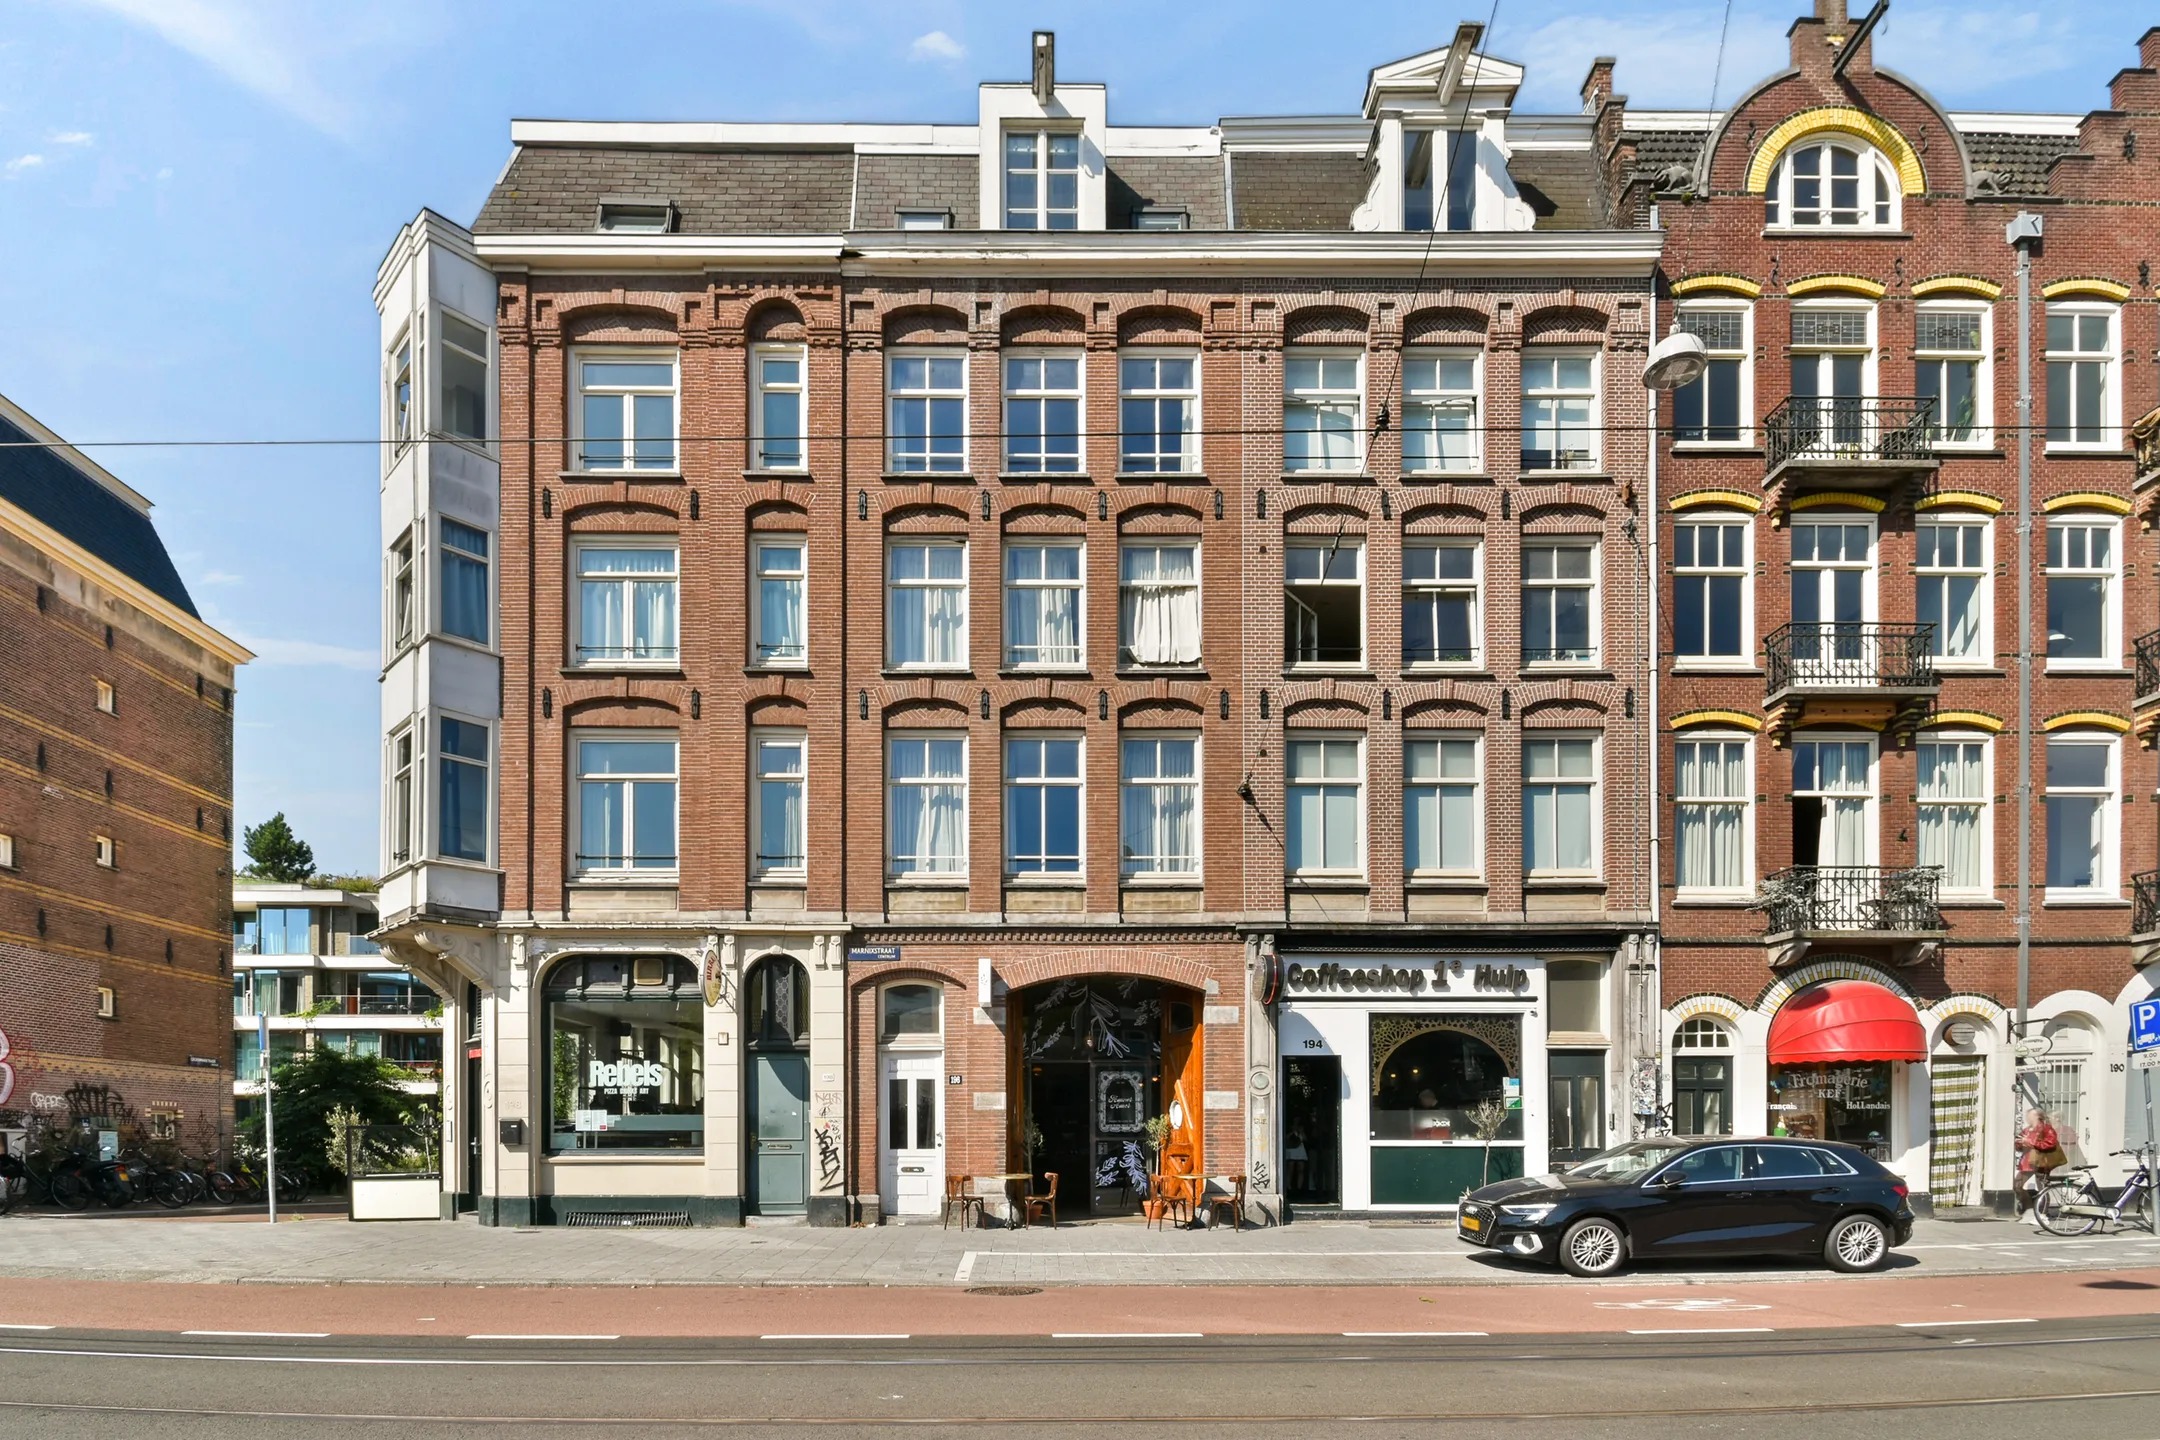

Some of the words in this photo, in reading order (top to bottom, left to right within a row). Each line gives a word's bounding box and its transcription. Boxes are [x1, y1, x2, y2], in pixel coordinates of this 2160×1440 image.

[1287, 962, 1424, 991] Coffeeshop
[1473, 963, 1528, 991] Hulp
[2138, 1004, 2156, 1030] P
[1302, 1039, 1323, 1049] 194
[588, 1060, 663, 1088] Rebels
[2110, 1063, 2125, 1073] 190
[950, 1075, 961, 1084] 196
[1790, 1073, 1868, 1089] Fromagerie
